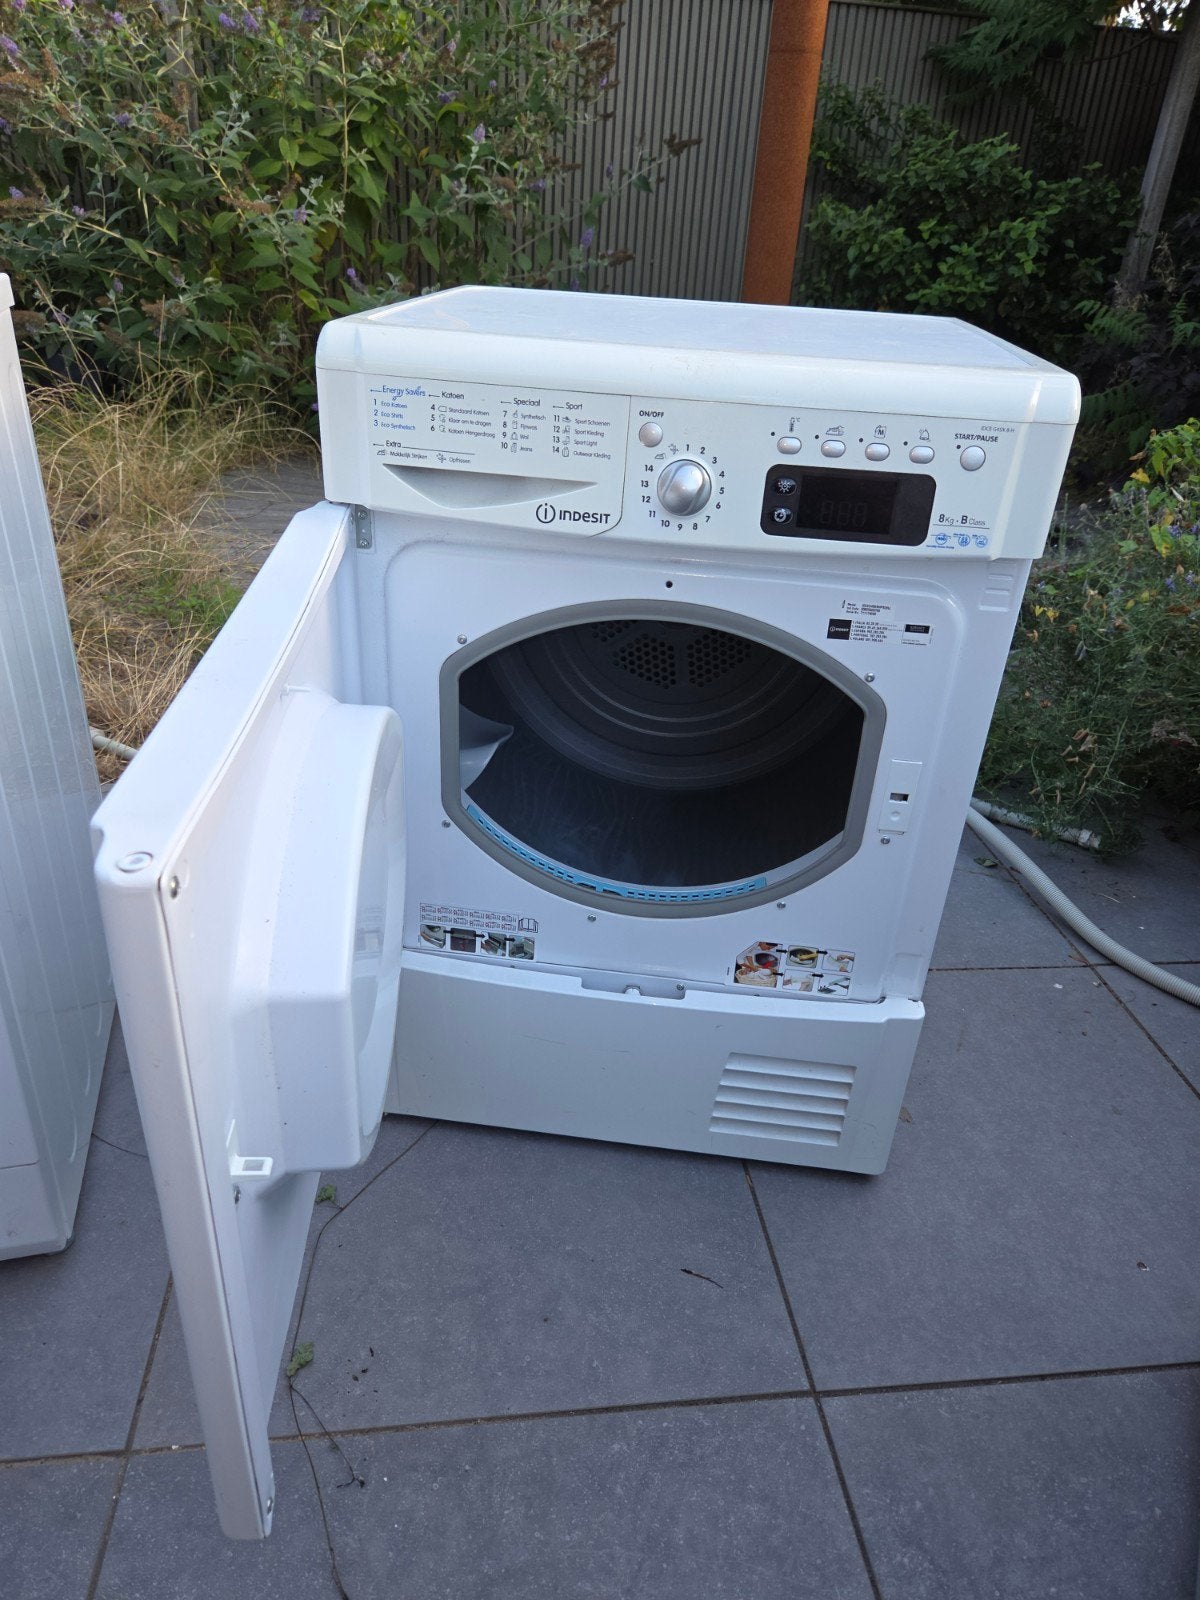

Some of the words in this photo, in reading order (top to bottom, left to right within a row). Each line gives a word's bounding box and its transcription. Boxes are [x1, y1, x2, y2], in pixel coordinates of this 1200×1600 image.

[382, 385, 404, 397] Energy
[442, 391, 464, 400] Katoen
[514, 398, 540, 406] Speciaal
[566, 402, 582, 410] Sport
[473, 408, 490, 416] Katoen
[503, 410, 507, 418] 7
[639, 410, 664, 418] ON/OFF
[475, 419, 491, 427] drogen
[502, 431, 507, 439] 9
[587, 430, 604, 438] Kleding
[954, 433, 998, 442] START/PAUSE
[386, 440, 401, 448] Extra
[552, 446, 560, 454] 14
[700, 446, 706, 454] 2
[712, 456, 717, 464] 3
[645, 464, 654, 472] 14
[719, 487, 724, 495] 5
[649, 510, 656, 518] 11
[705, 515, 711, 523] 7
[693, 522, 698, 530] 8
